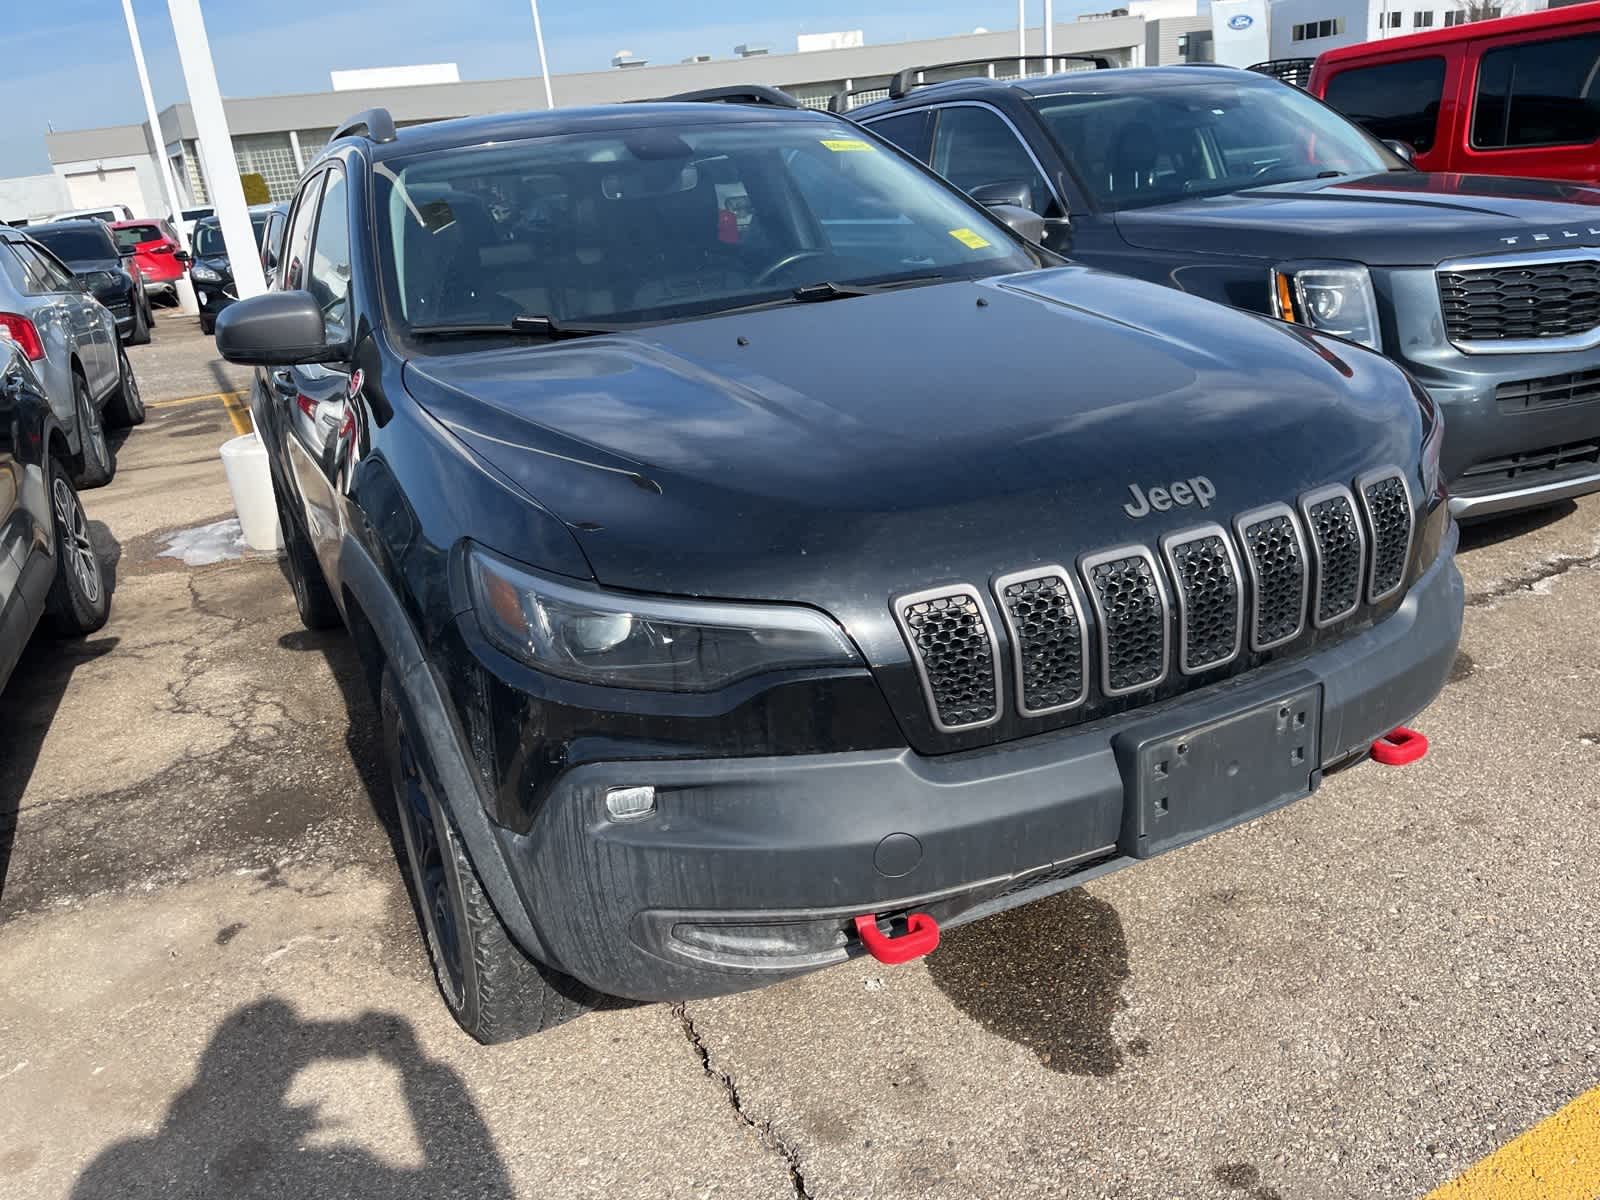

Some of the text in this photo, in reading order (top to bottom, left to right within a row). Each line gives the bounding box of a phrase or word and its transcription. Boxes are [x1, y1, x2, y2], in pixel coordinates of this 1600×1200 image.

[1233, 16, 1251, 27] Ford
[1500, 228, 1600, 245] TELL
[1122, 475, 1217, 519] Jeep
